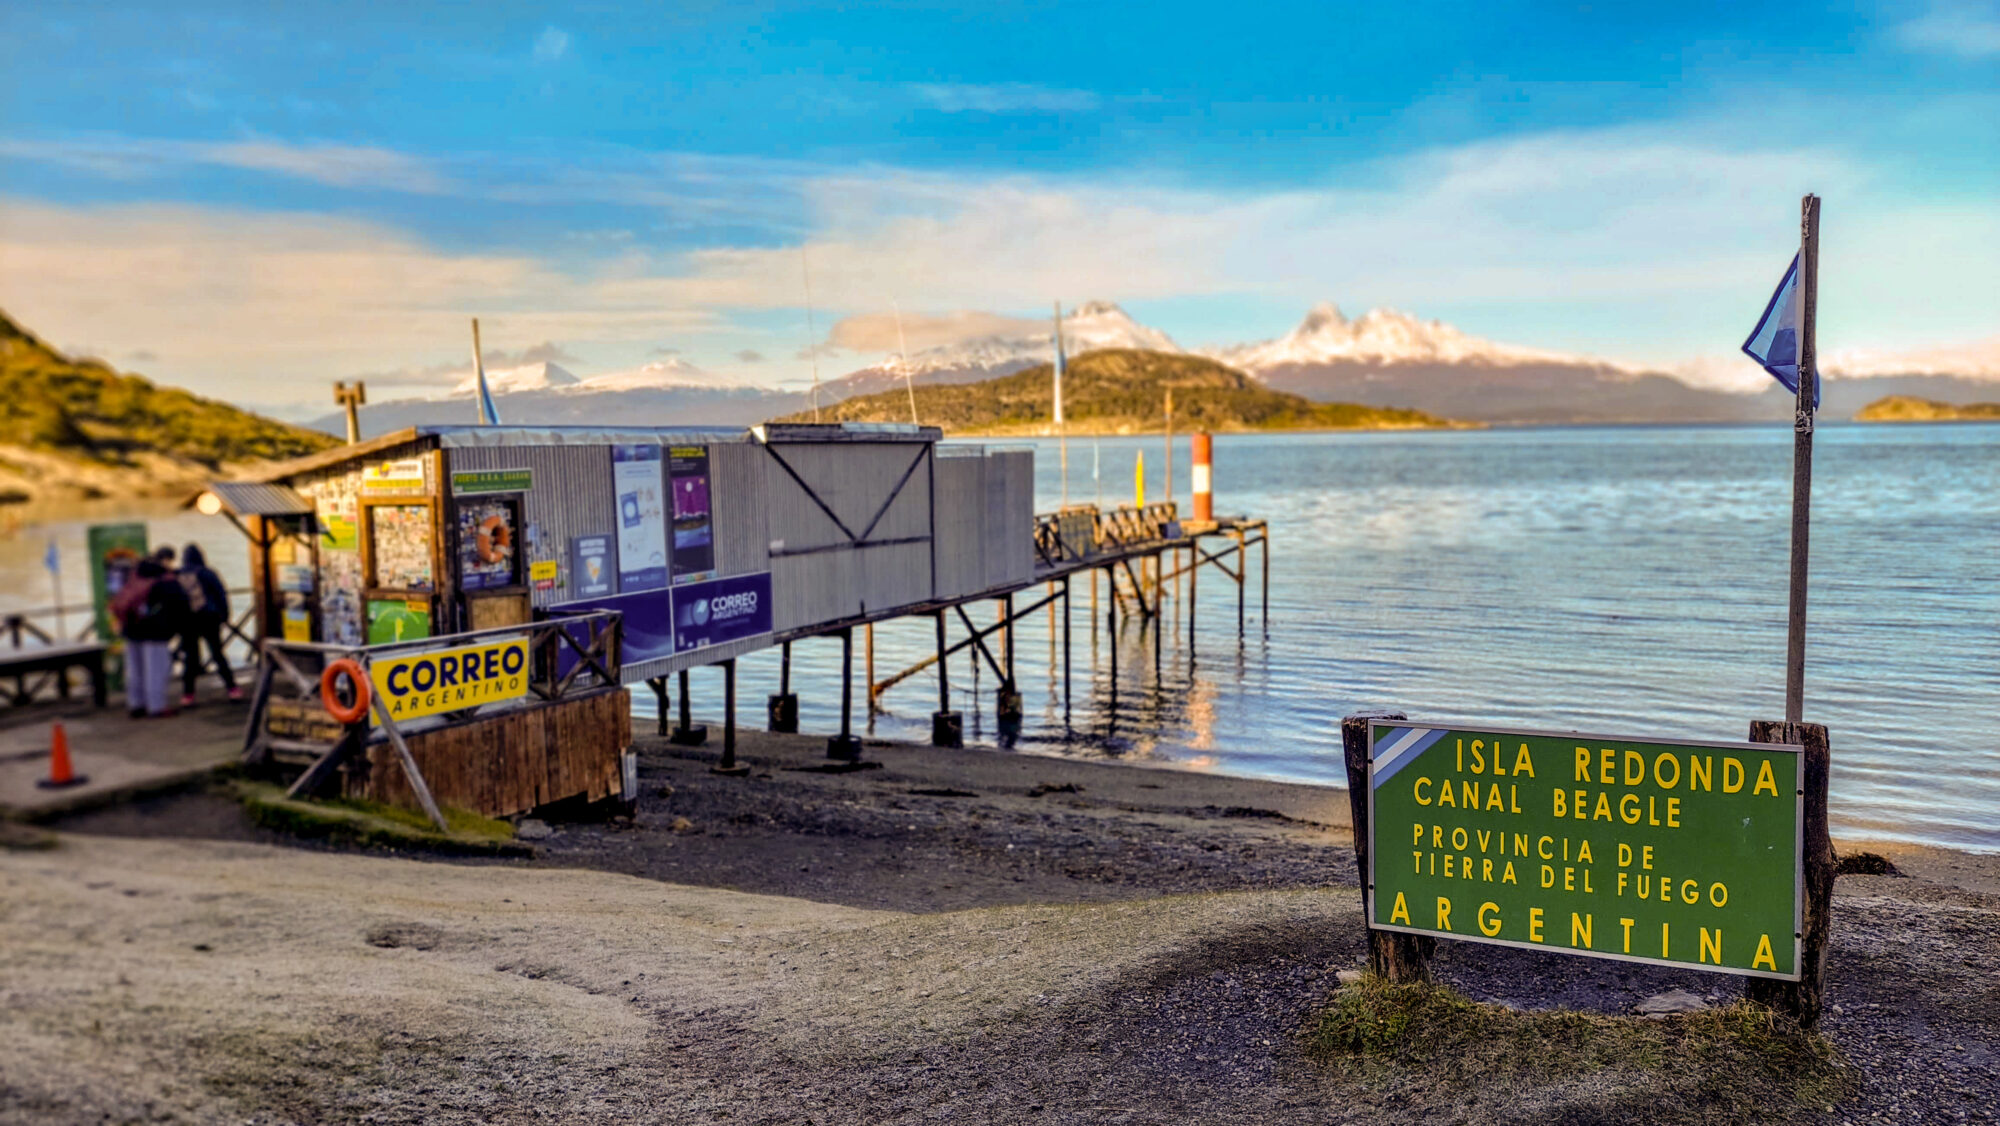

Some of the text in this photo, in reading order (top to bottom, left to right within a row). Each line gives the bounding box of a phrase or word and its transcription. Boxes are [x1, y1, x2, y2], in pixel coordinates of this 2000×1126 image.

[711, 591, 758, 612] CORREO
[711, 605, 757, 620] ARGENTINO
[387, 645, 524, 697] CORREO
[392, 677, 519, 714] ARGENTINO
[1456, 739, 1779, 798] ISLA REDONDA
[1413, 776, 1682, 829] CANAL BEAGLE
[1412, 823, 1655, 871] PROVINCIA DE
[1412, 850, 1730, 909] TIERRA DEL FUEGO
[1389, 890, 1778, 972] ARGENTINA
